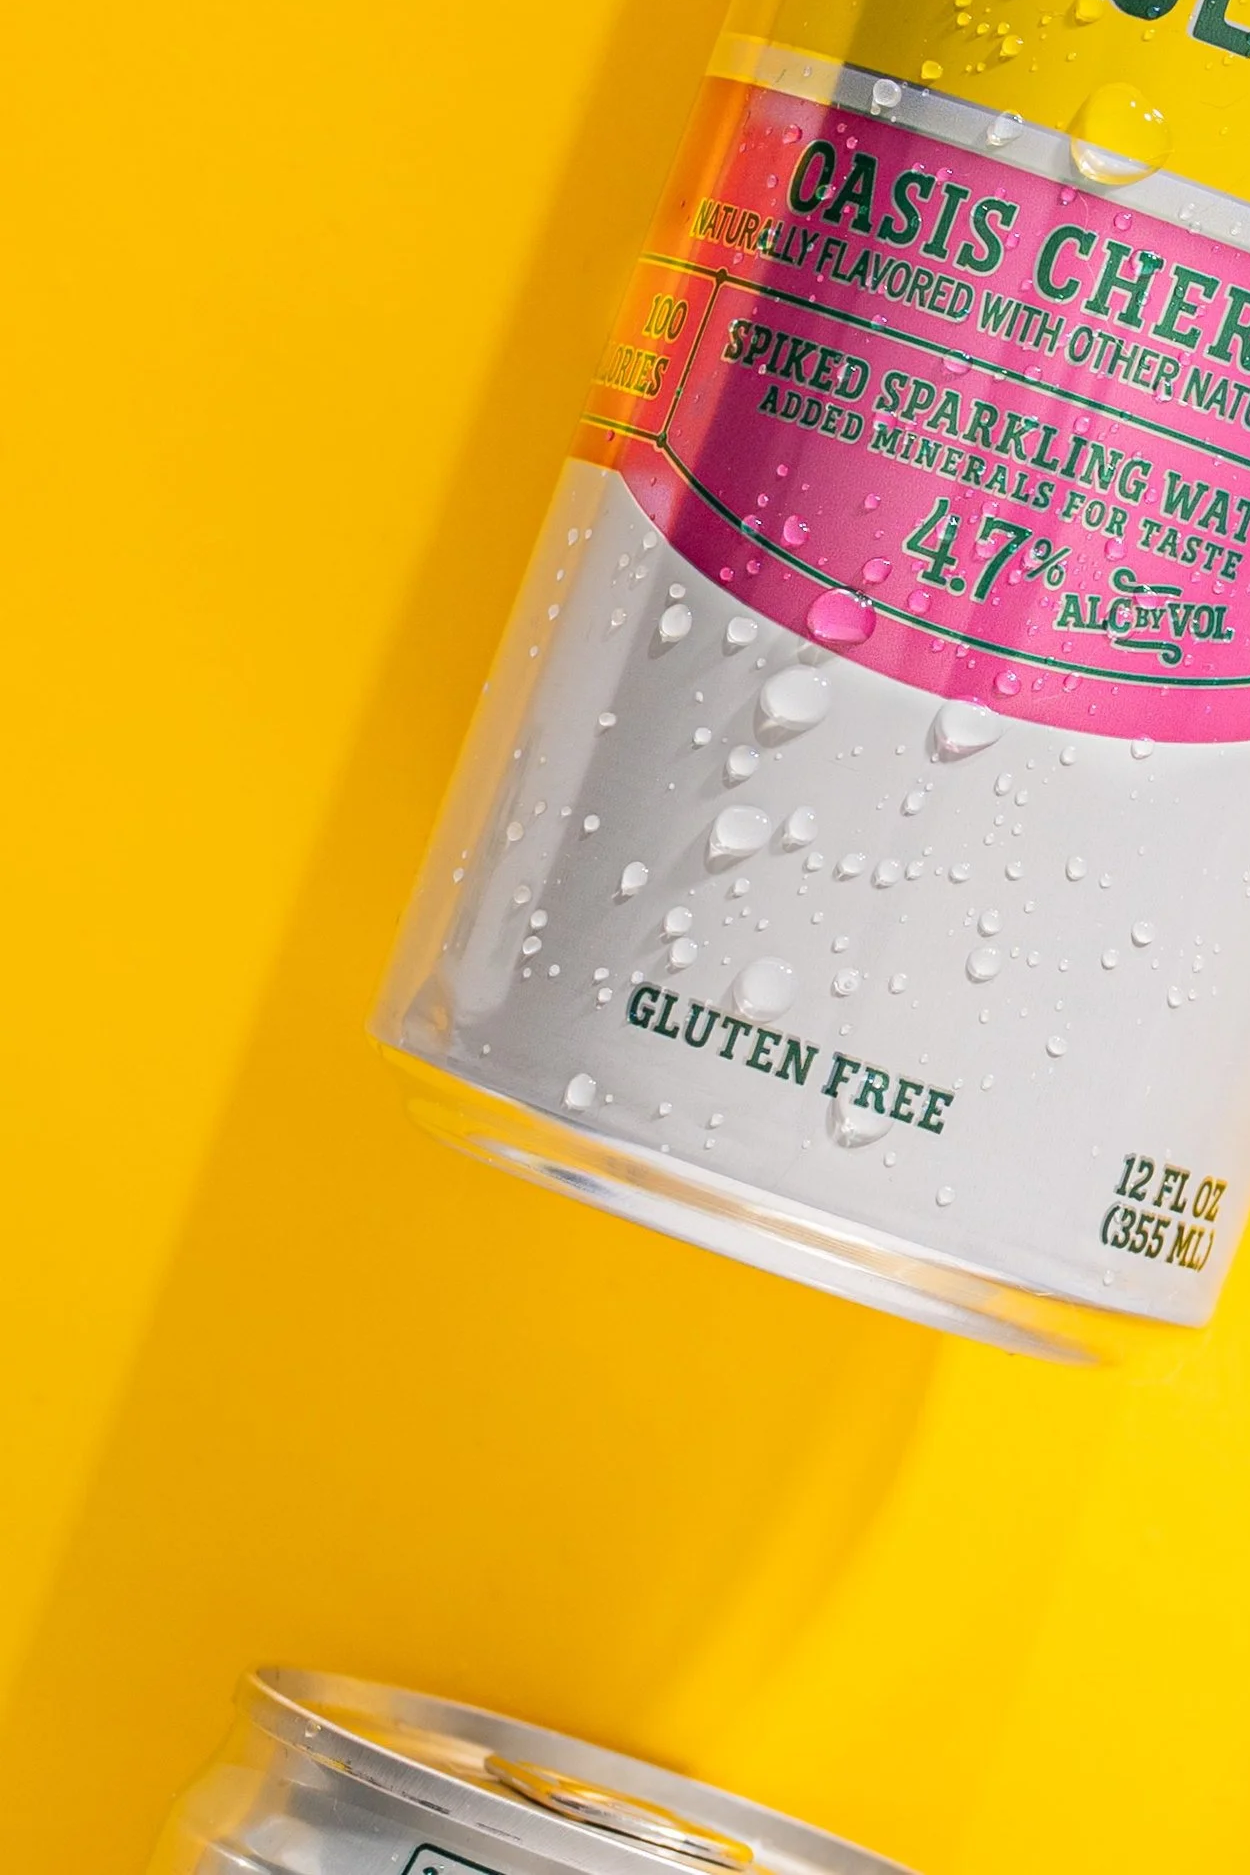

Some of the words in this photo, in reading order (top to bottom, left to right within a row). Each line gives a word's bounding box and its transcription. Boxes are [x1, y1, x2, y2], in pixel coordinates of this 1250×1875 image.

[788, 139, 1020, 277] OASIS
[642, 293, 689, 344] 100
[689, 197, 820, 268] NATURALLY
[815, 236, 976, 324] FLAVORED
[976, 290, 1067, 357] WITH
[1067, 323, 1182, 402] OTHER
[720, 318, 871, 403] SPIKED
[873, 369, 1153, 507] SPARKLING
[758, 384, 864, 444] ADDED
[869, 422, 1056, 511] MINERALS
[1061, 490, 1130, 538] FOR
[1136, 518, 1244, 583] TASTE
[626, 981, 817, 1086] GLUTEN
[821, 1050, 955, 1135] FREE
[1100, 1200, 1172, 1259] (355
[1165, 1221, 1215, 1273] ML)
[1113, 1152, 1156, 1203] 12
[1152, 1163, 1191, 1214] FL
[1191, 1175, 1229, 1223] OZ
